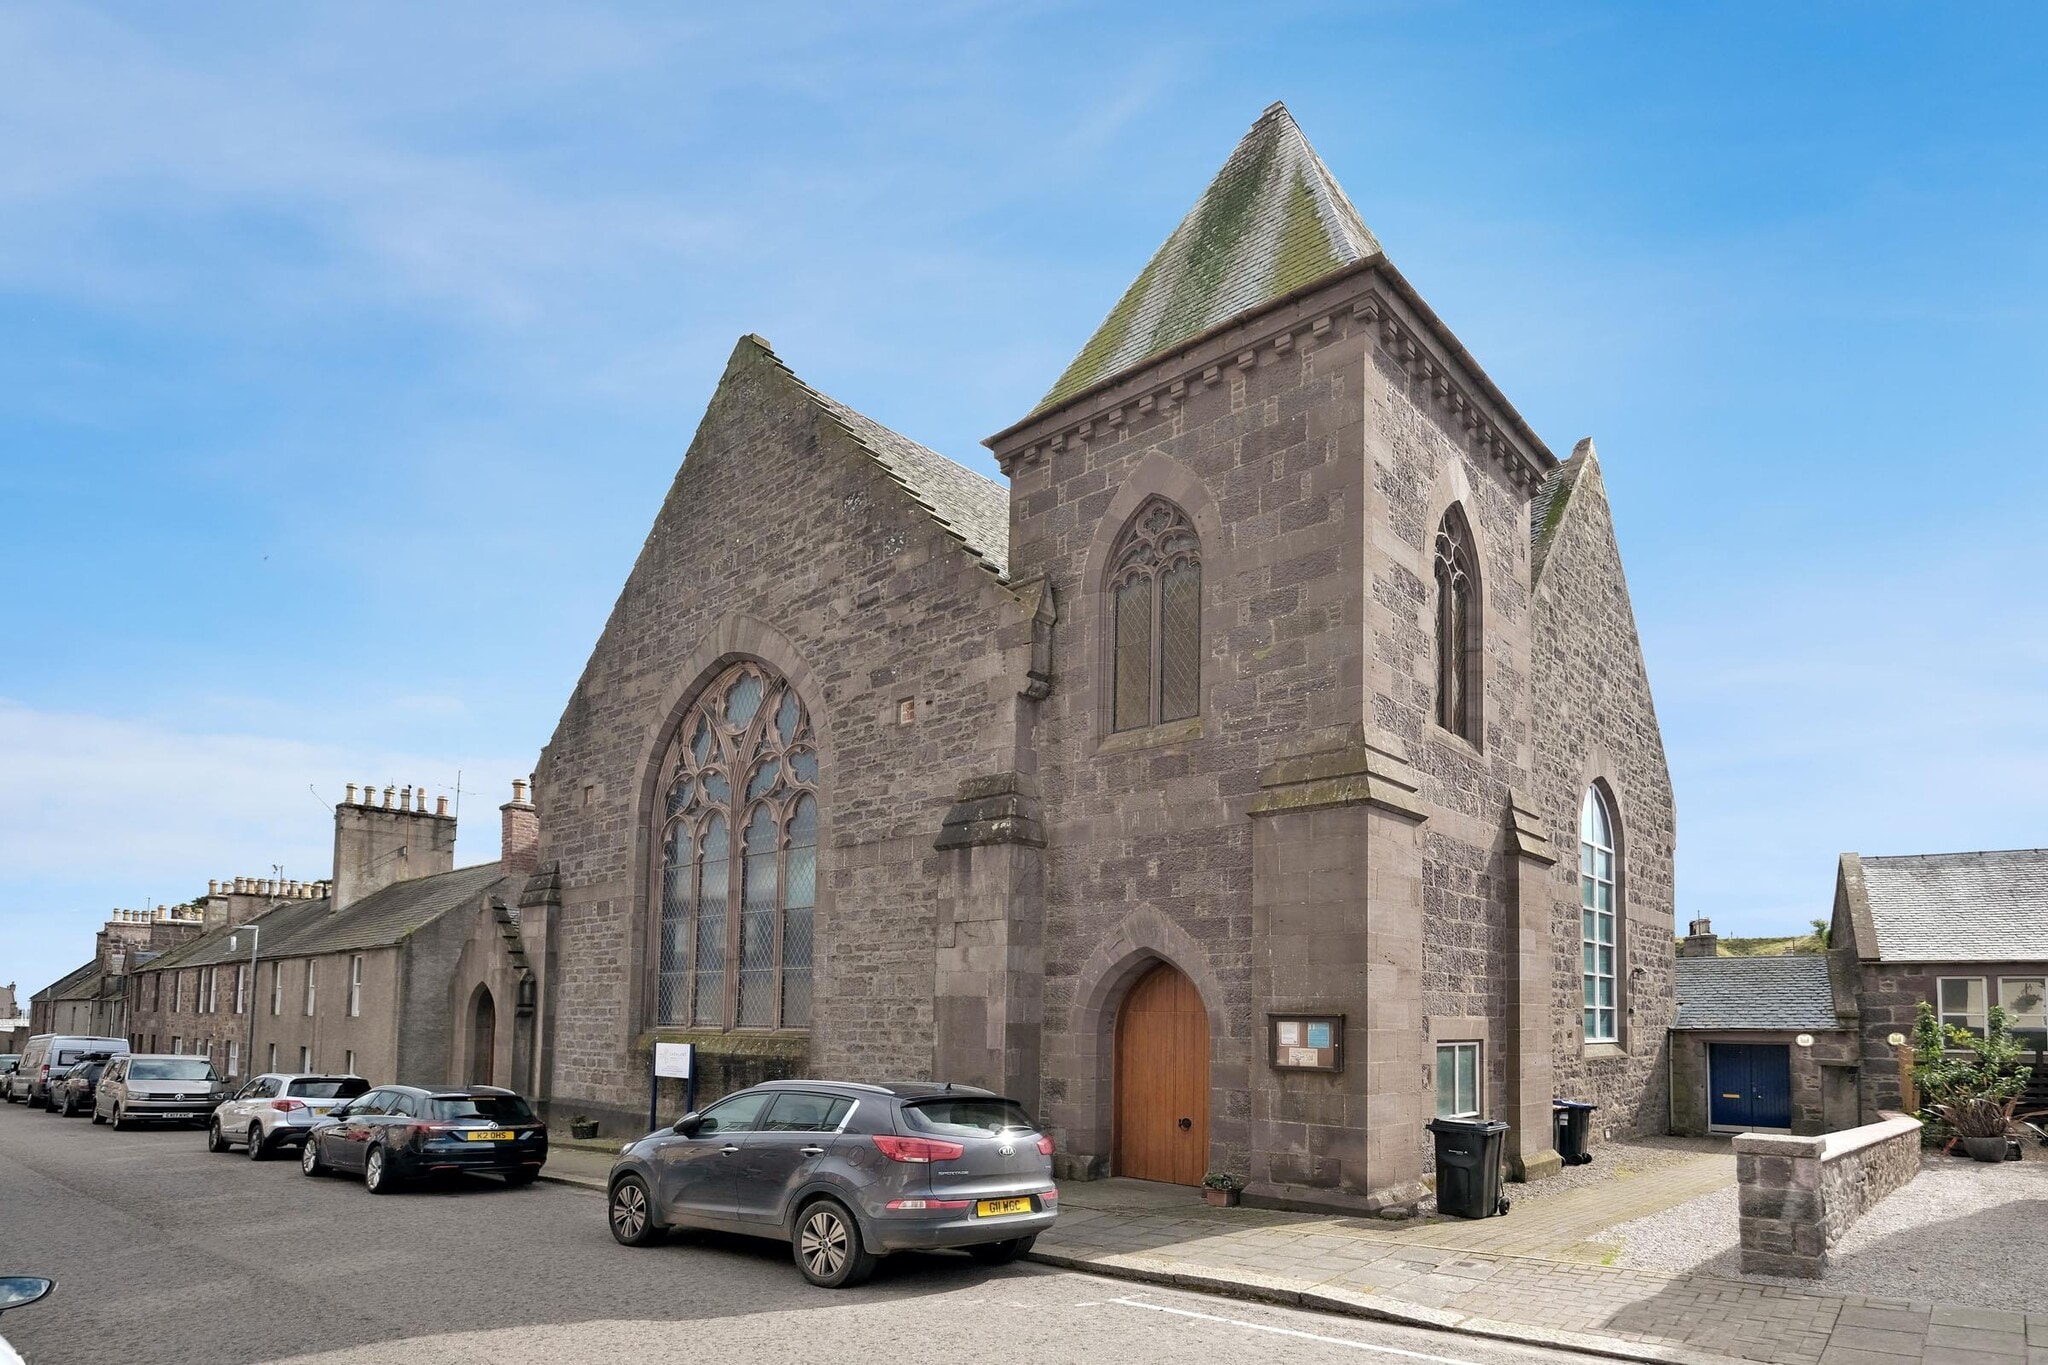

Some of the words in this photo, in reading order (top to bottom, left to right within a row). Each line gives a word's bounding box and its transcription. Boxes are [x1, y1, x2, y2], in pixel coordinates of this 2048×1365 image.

[1001, 1146, 1015, 1156] KIA
[989, 1201, 1001, 1213] G11
[1003, 1200, 1021, 1212] WGC
